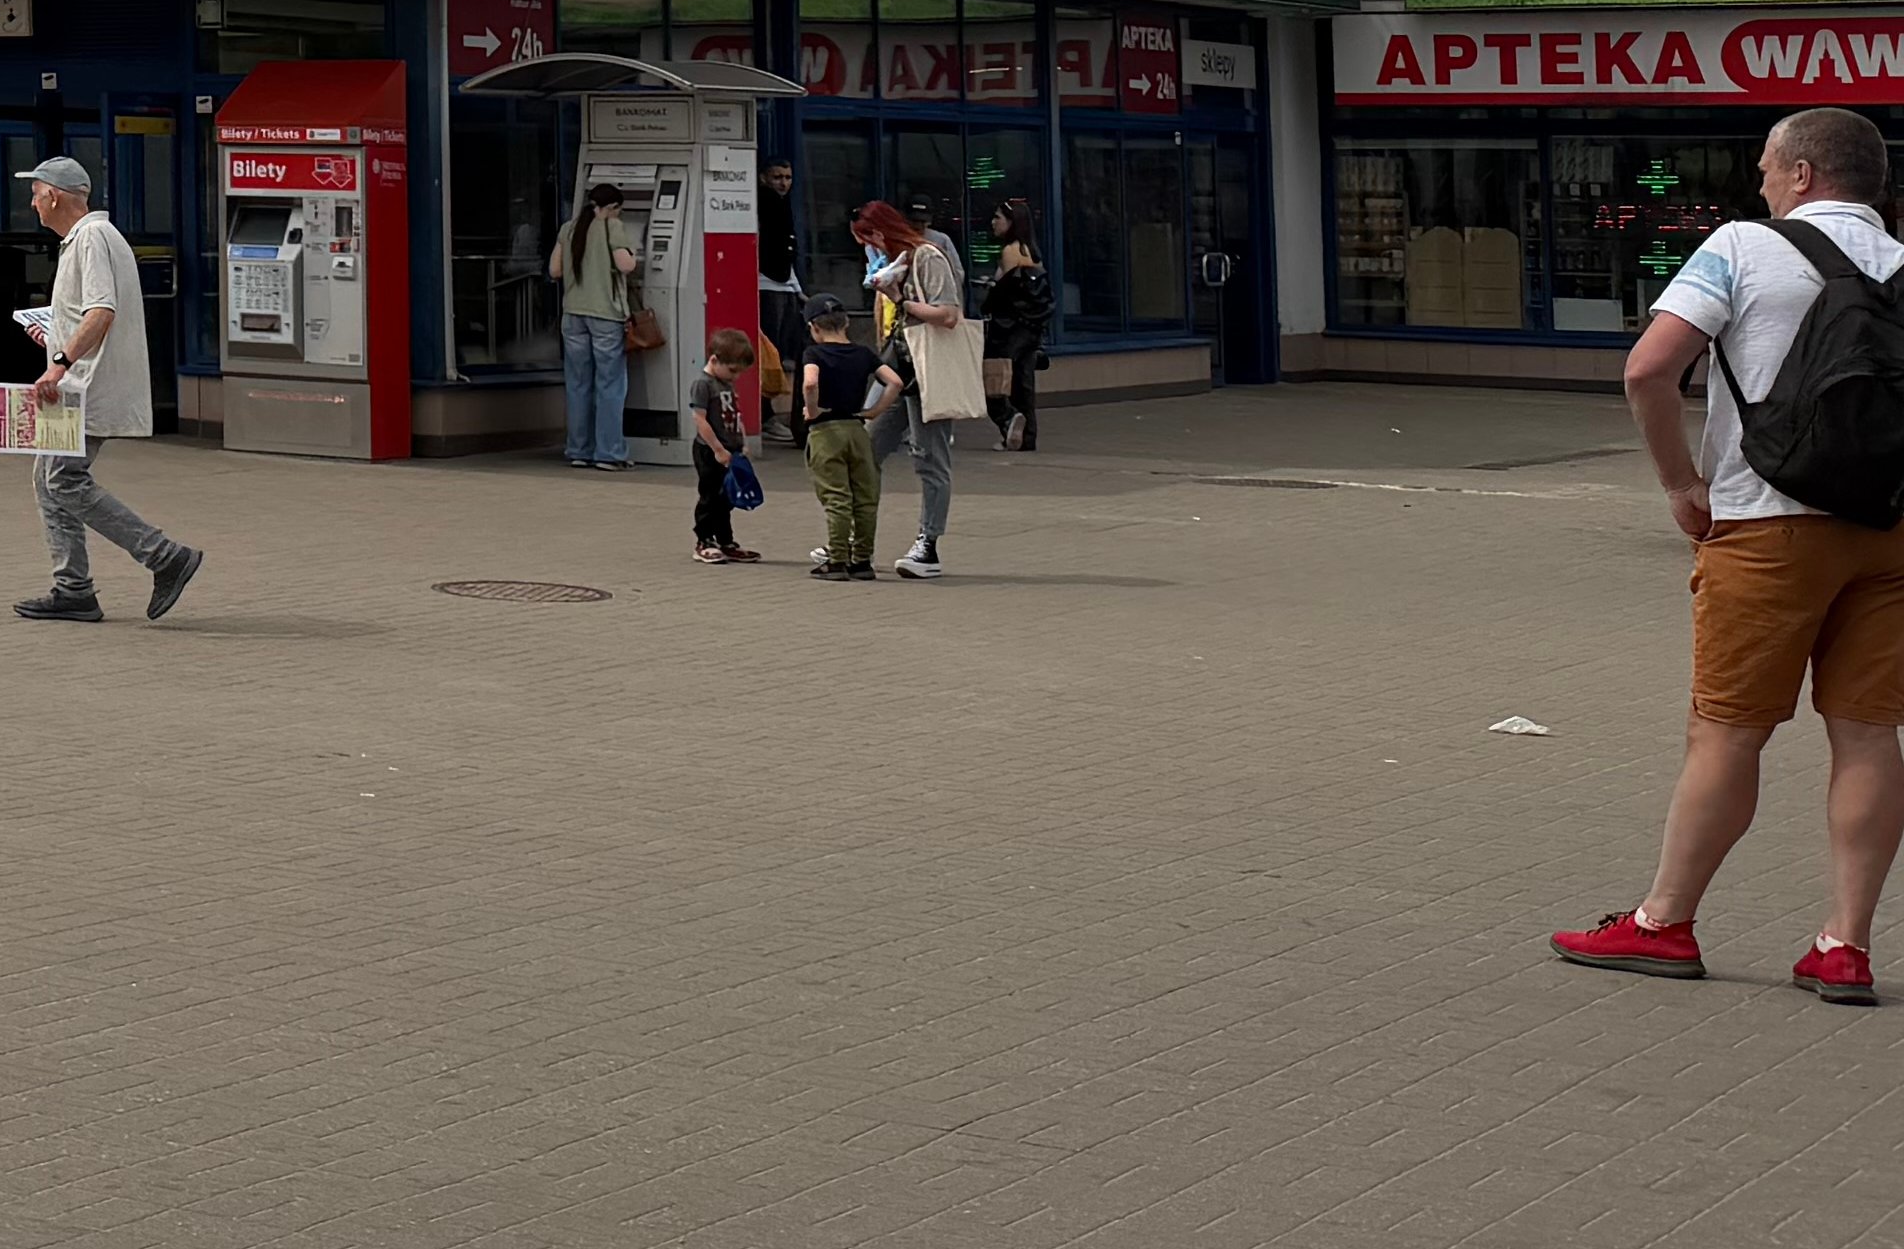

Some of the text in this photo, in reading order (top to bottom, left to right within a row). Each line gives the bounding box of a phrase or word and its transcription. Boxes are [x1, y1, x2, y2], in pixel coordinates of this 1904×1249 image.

[511, 26, 542, 62] 24h
[1122, 25, 1174, 52] APTEKA
[1201, 47, 1236, 82] sklepy
[1376, 28, 1904, 87] APTEKA WAW
[1156, 72, 1177, 100] 24h
[221, 128, 255, 141] Bilety
[261, 128, 300, 140] Tickets
[232, 160, 287, 182] Bilety
